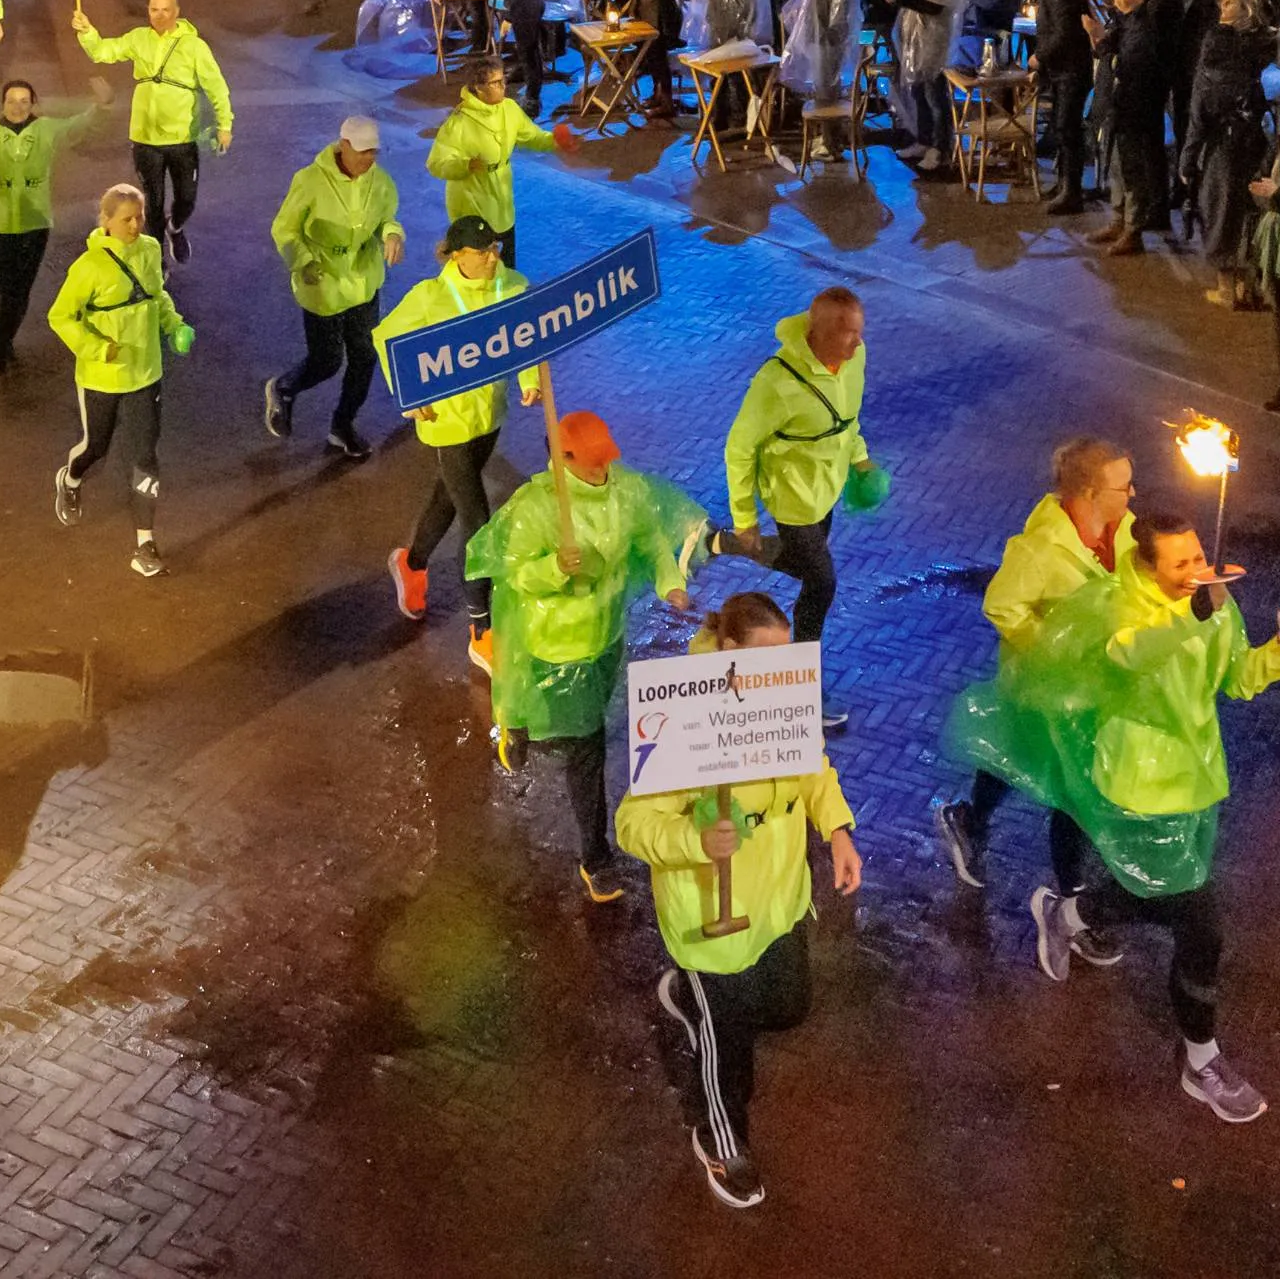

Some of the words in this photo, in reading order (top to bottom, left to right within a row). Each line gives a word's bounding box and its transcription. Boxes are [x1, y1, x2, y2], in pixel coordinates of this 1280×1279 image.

[416, 262, 640, 384] Medemblik
[708, 703, 815, 728] Wageningen
[717, 725, 810, 749] Medemblik
[741, 749, 771, 768] 145
[776, 747, 802, 763] km
